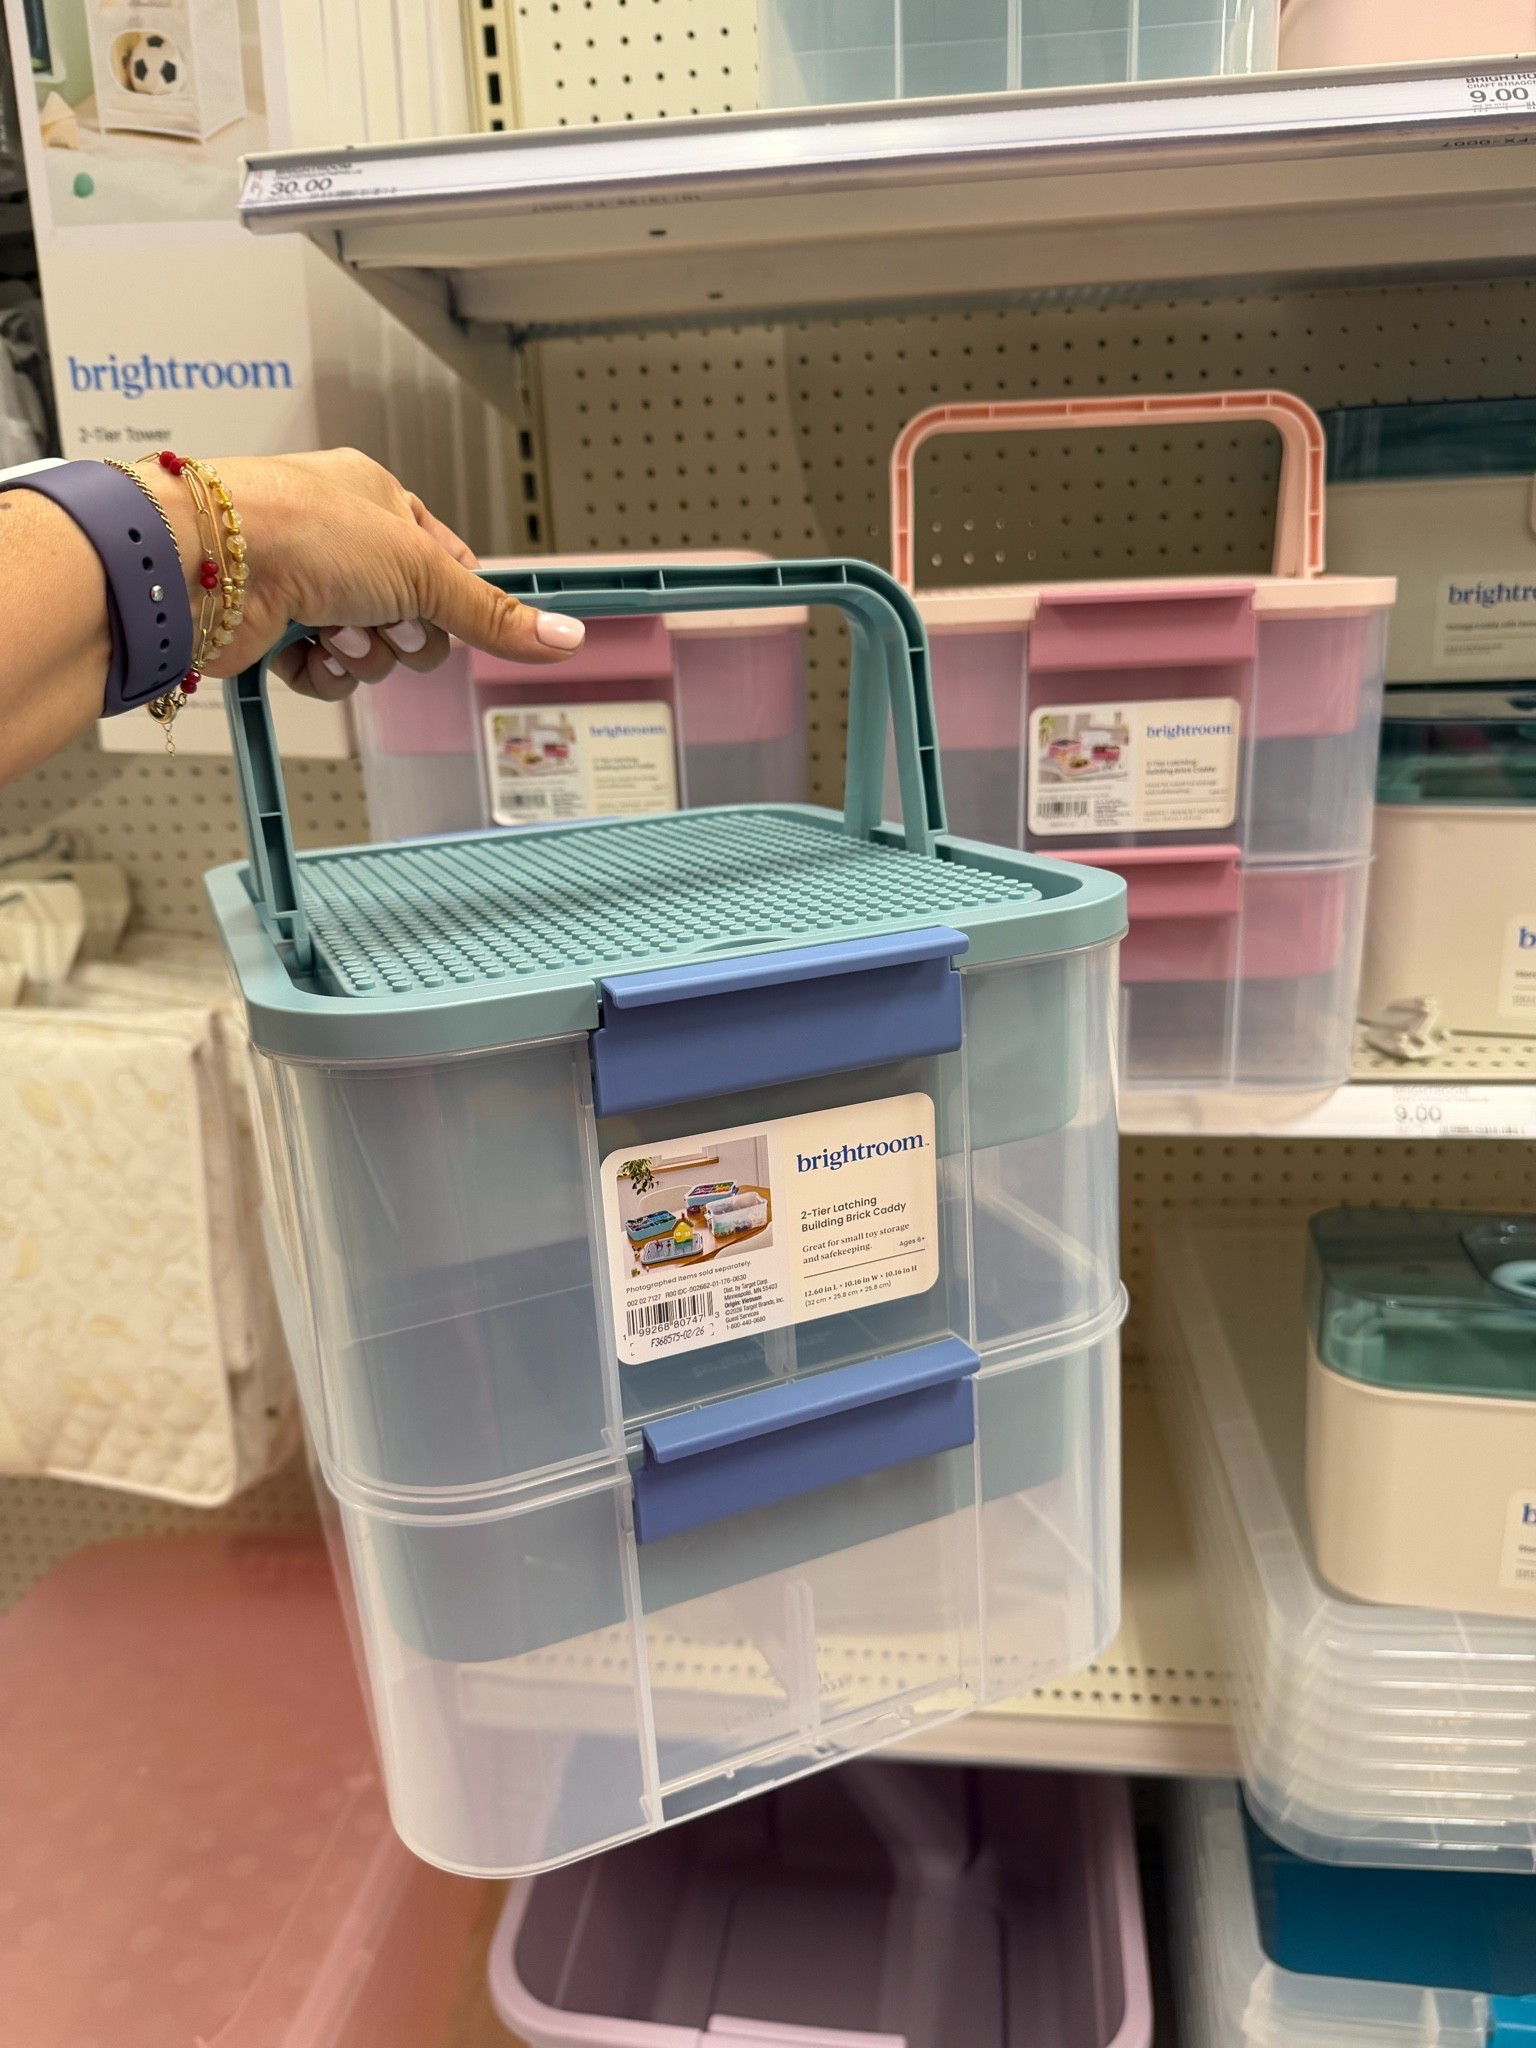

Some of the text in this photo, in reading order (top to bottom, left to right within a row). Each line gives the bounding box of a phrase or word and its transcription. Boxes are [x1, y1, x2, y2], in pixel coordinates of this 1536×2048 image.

[1470, 87, 1529, 103] 9.00
[270, 177, 333, 196] 30.00
[68, 354, 293, 400] brightroom
[79, 427, 171, 443] 2-Tier Tower
[1147, 725, 1231, 740] brightroom
[1395, 1105, 1442, 1122] 9.00
[796, 1134, 924, 1172] brightroom
[801, 1197, 877, 1220] 2-Tier Latching
[801, 1202, 906, 1232] Building Brick Caddy
[802, 1223, 910, 1253] Great for small toy storage
[899, 1238, 916, 1248] Ages
[803, 1244, 873, 1264] and safekeeping.
[626, 1260, 752, 1294] Photographed items sold separately.
[735, 1284, 741, 1293] by
[742, 1281, 756, 1292] Target
[757, 1278, 768, 1288] Corp.
[804, 1287, 824, 1297] 12.60
[824, 1285, 832, 1293] in
[844, 1278, 862, 1288] 10.16
[885, 1269, 902, 1278] 10.16
[902, 1267, 911, 1275] in
[911, 1264, 917, 1272] H
[753, 1286, 762, 1295] MN
[762, 1283, 778, 1293] 55403
[805, 1297, 815, 1308] (32
[833, 1291, 847, 1300] 25.8
[864, 1284, 878, 1292] 25.8
[879, 1280, 892, 1290] cm)
[627, 1298, 638, 1307] 002
[647, 1294, 662, 1303] 7127
[724, 1295, 762, 1309] Origin: Vietnam
[743, 1302, 758, 1312] Target
[758, 1299, 775, 1309] Brands,
[638, 1324, 670, 1337] 99268
[674, 1314, 704, 1329] 80747
[725, 1310, 760, 1324] Guest Services
